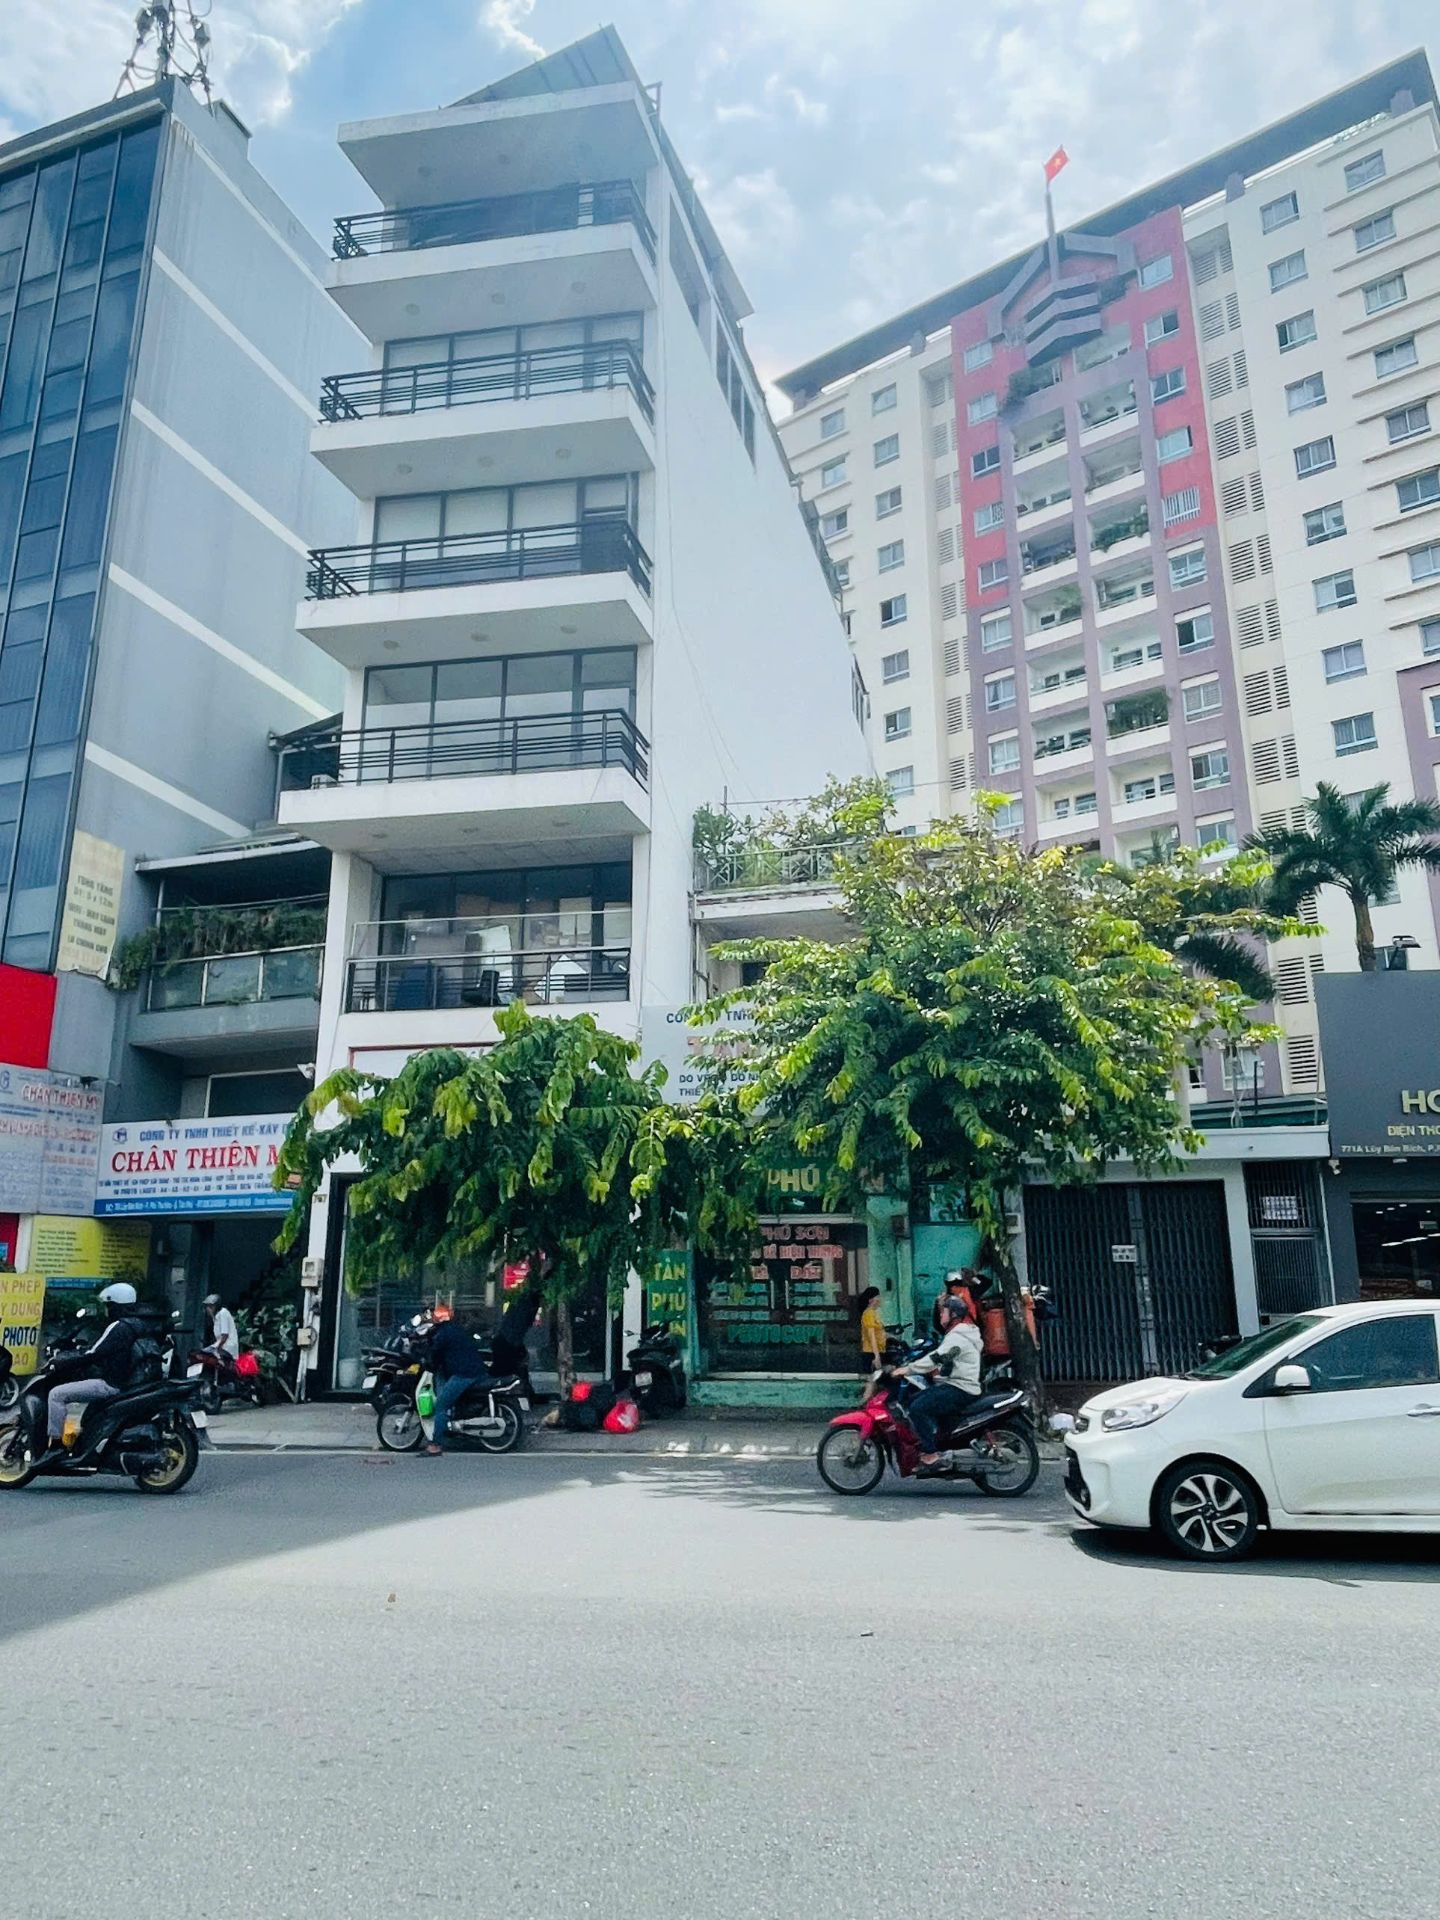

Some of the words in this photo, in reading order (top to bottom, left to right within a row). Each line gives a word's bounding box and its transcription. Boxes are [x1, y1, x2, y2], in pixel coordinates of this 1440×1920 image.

[111, 1143, 178, 1173] CHÂN
[185, 1139, 261, 1175] THIỆN
[654, 1256, 686, 1281] TÂN
[2, 1326, 37, 1347] PHOTO
